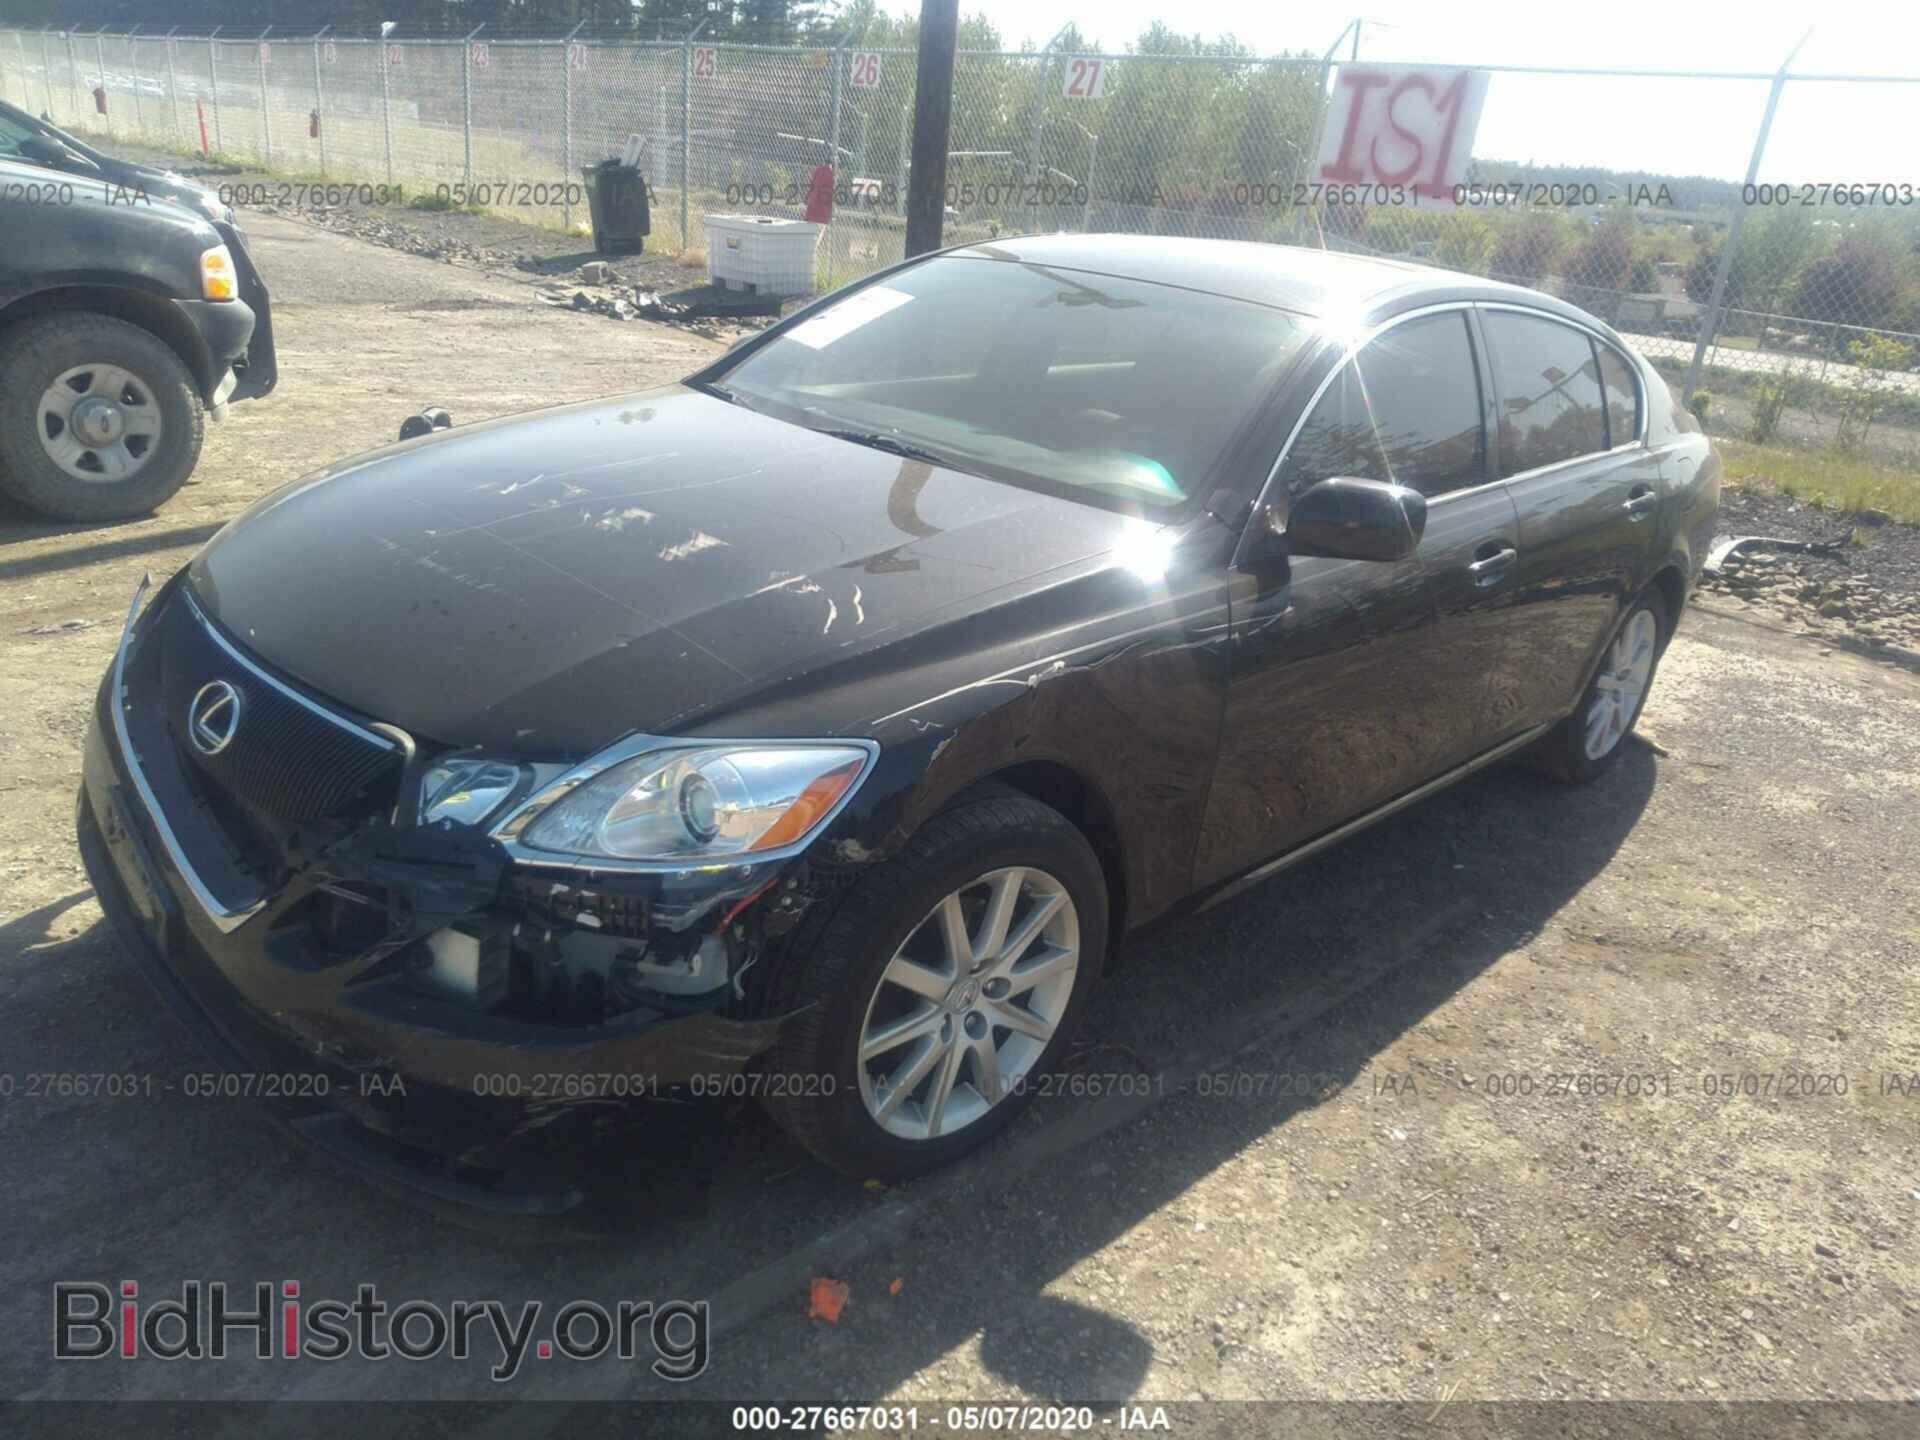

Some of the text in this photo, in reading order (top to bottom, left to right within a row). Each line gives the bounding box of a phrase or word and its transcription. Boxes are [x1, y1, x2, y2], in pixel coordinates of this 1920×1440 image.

[695, 49, 715, 78] 25
[852, 54, 878, 86] 26
[1068, 59, 1102, 97] 27
